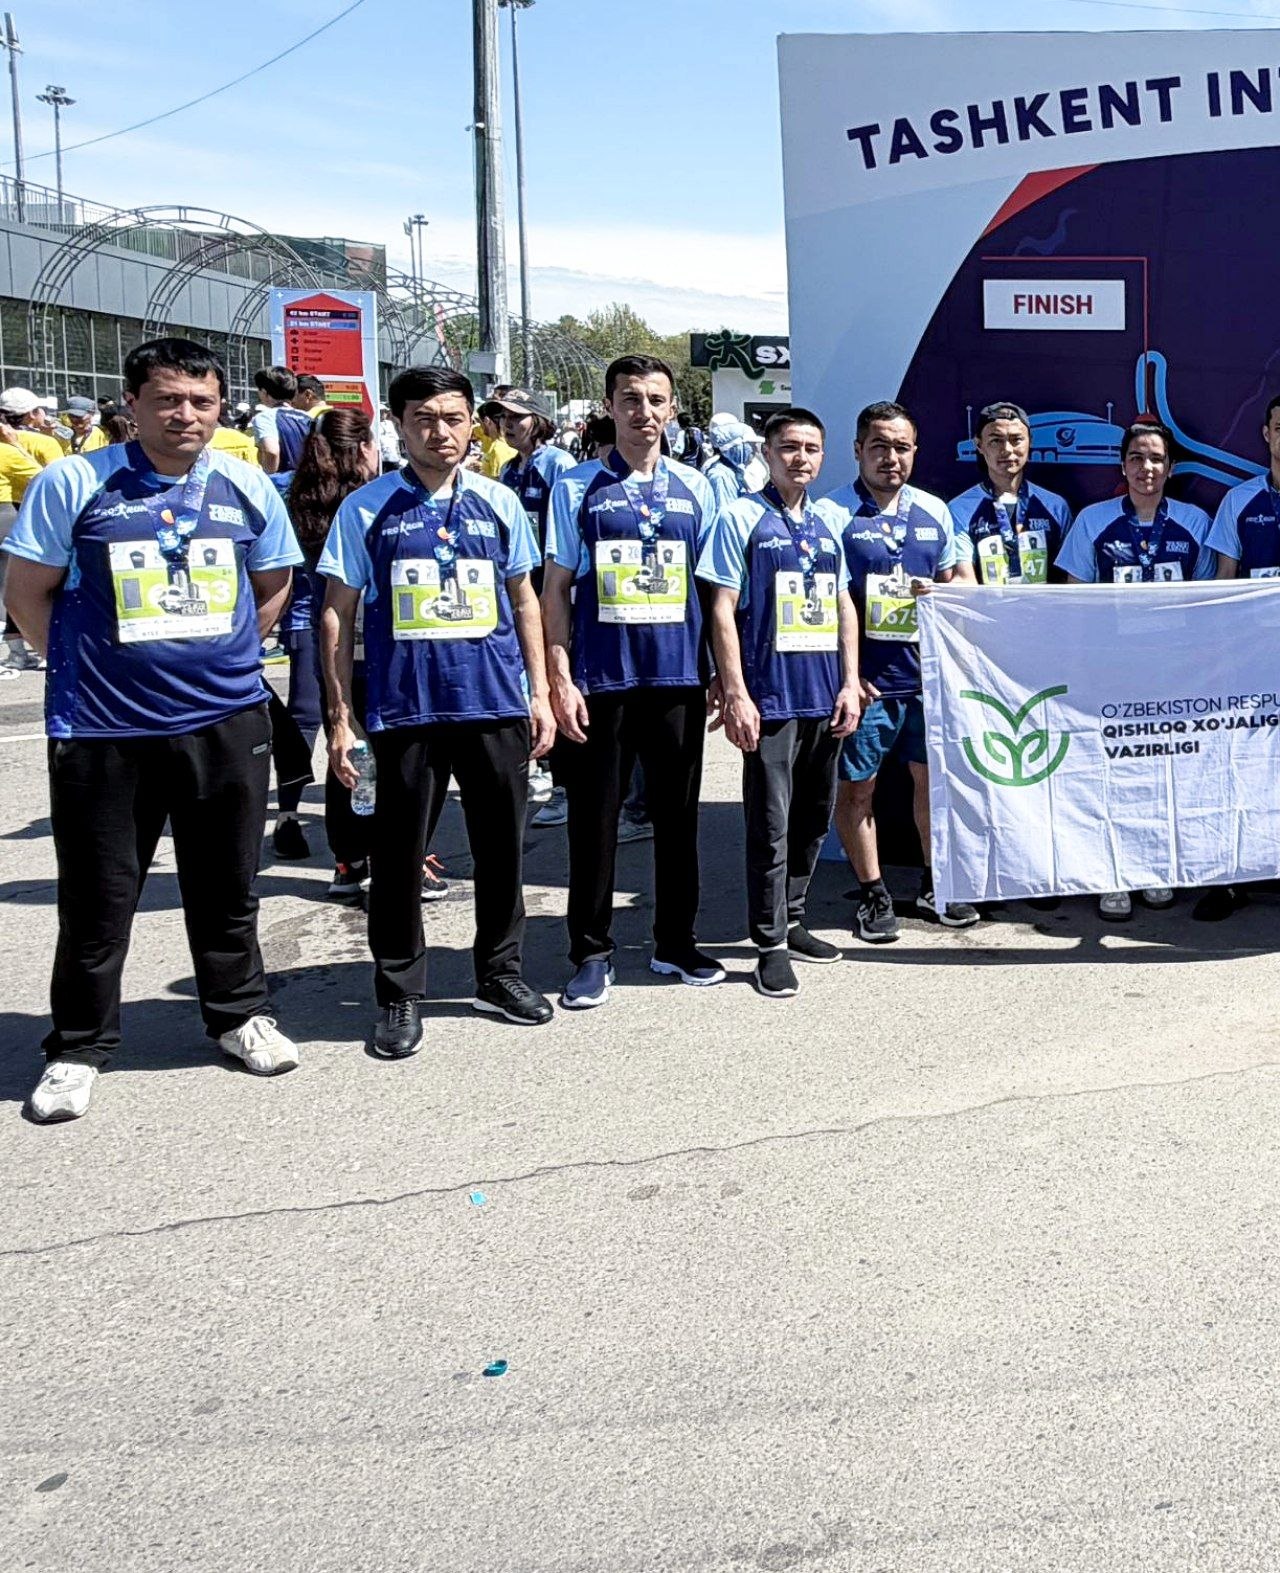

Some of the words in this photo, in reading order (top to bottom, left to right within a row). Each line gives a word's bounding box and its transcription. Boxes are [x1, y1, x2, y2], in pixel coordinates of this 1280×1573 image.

[847, 76, 1181, 169] TASHKENT
[1013, 294, 1092, 315] FINISH
[147, 580, 232, 604] 653
[1101, 696, 1222, 719] O'ZBEKISTON
[1103, 718, 1187, 738] QISHLOQ
[1104, 740, 1200, 760] VAZIRLIGI
